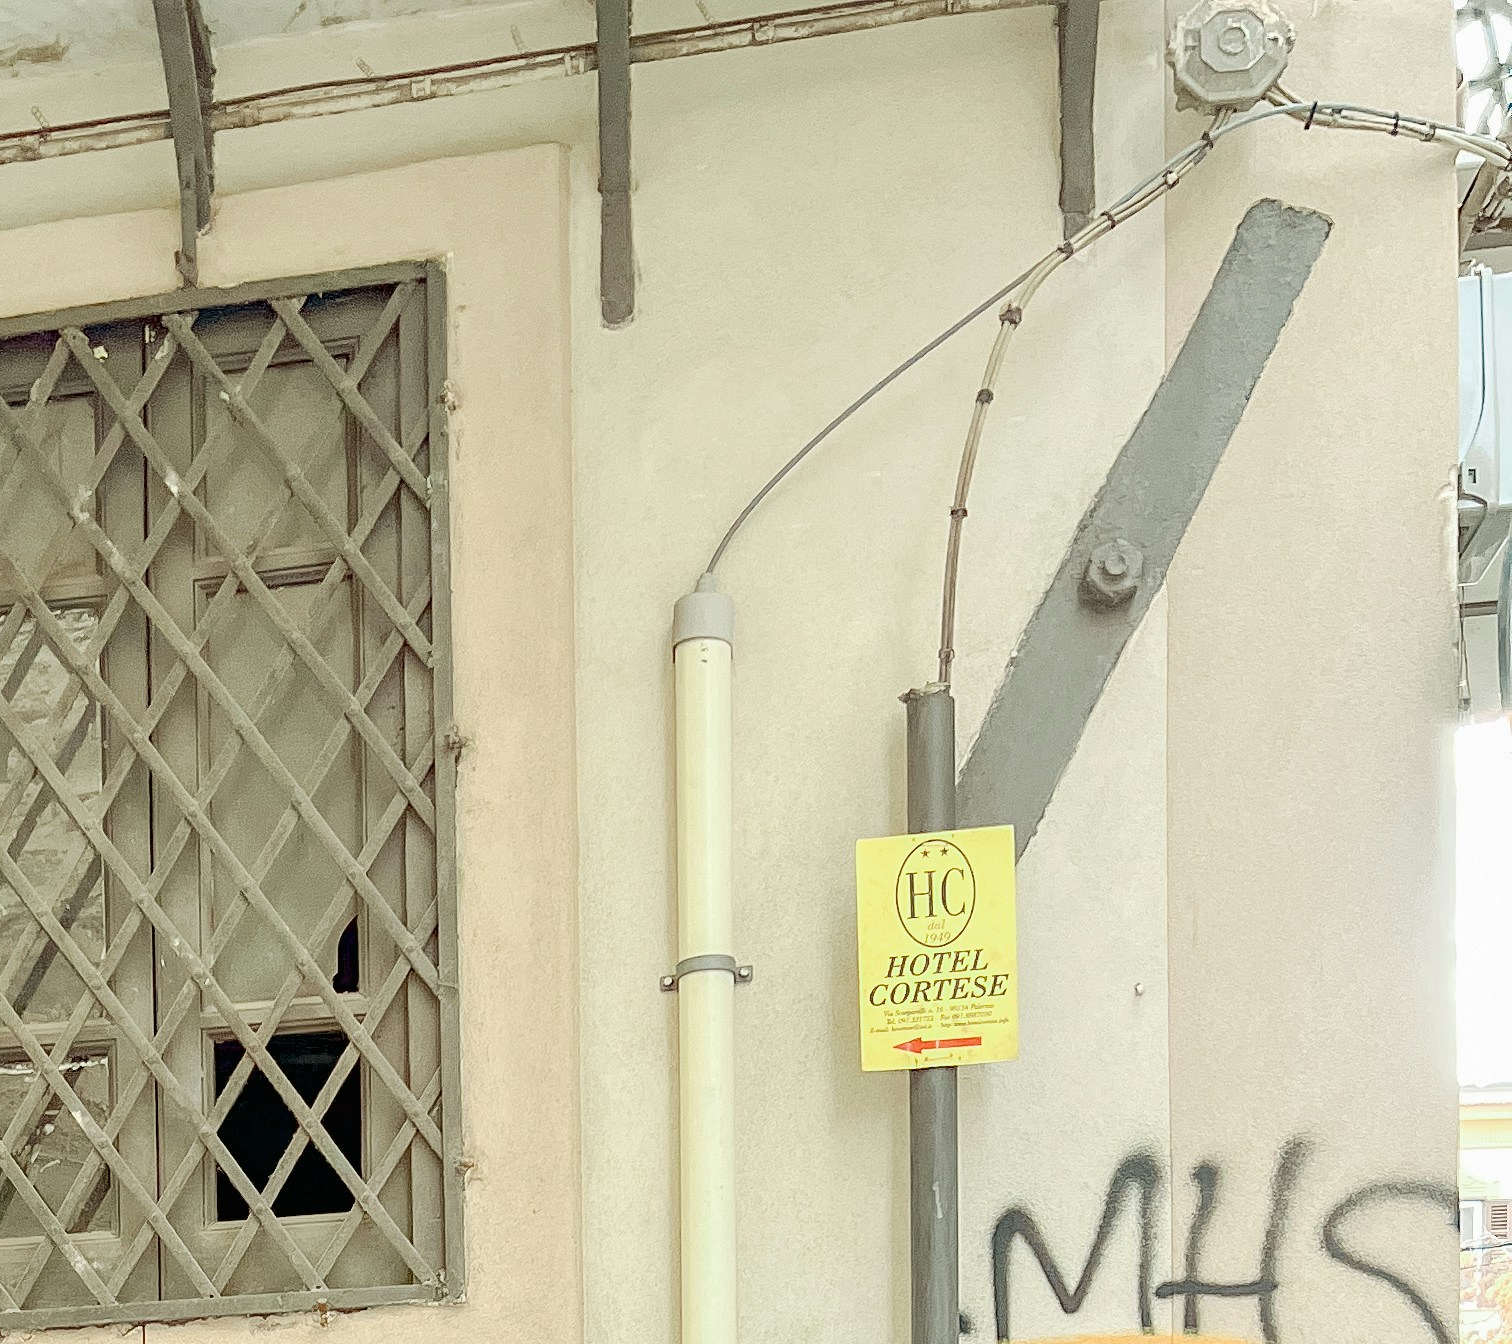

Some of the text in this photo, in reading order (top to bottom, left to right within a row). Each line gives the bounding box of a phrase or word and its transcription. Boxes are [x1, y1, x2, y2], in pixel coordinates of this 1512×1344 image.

[905, 867, 966, 920] HC
[924, 931, 952, 944] 1949
[927, 919, 946, 931] dal
[884, 949, 989, 979] HOTEL
[869, 974, 1009, 1007] CORTESE
